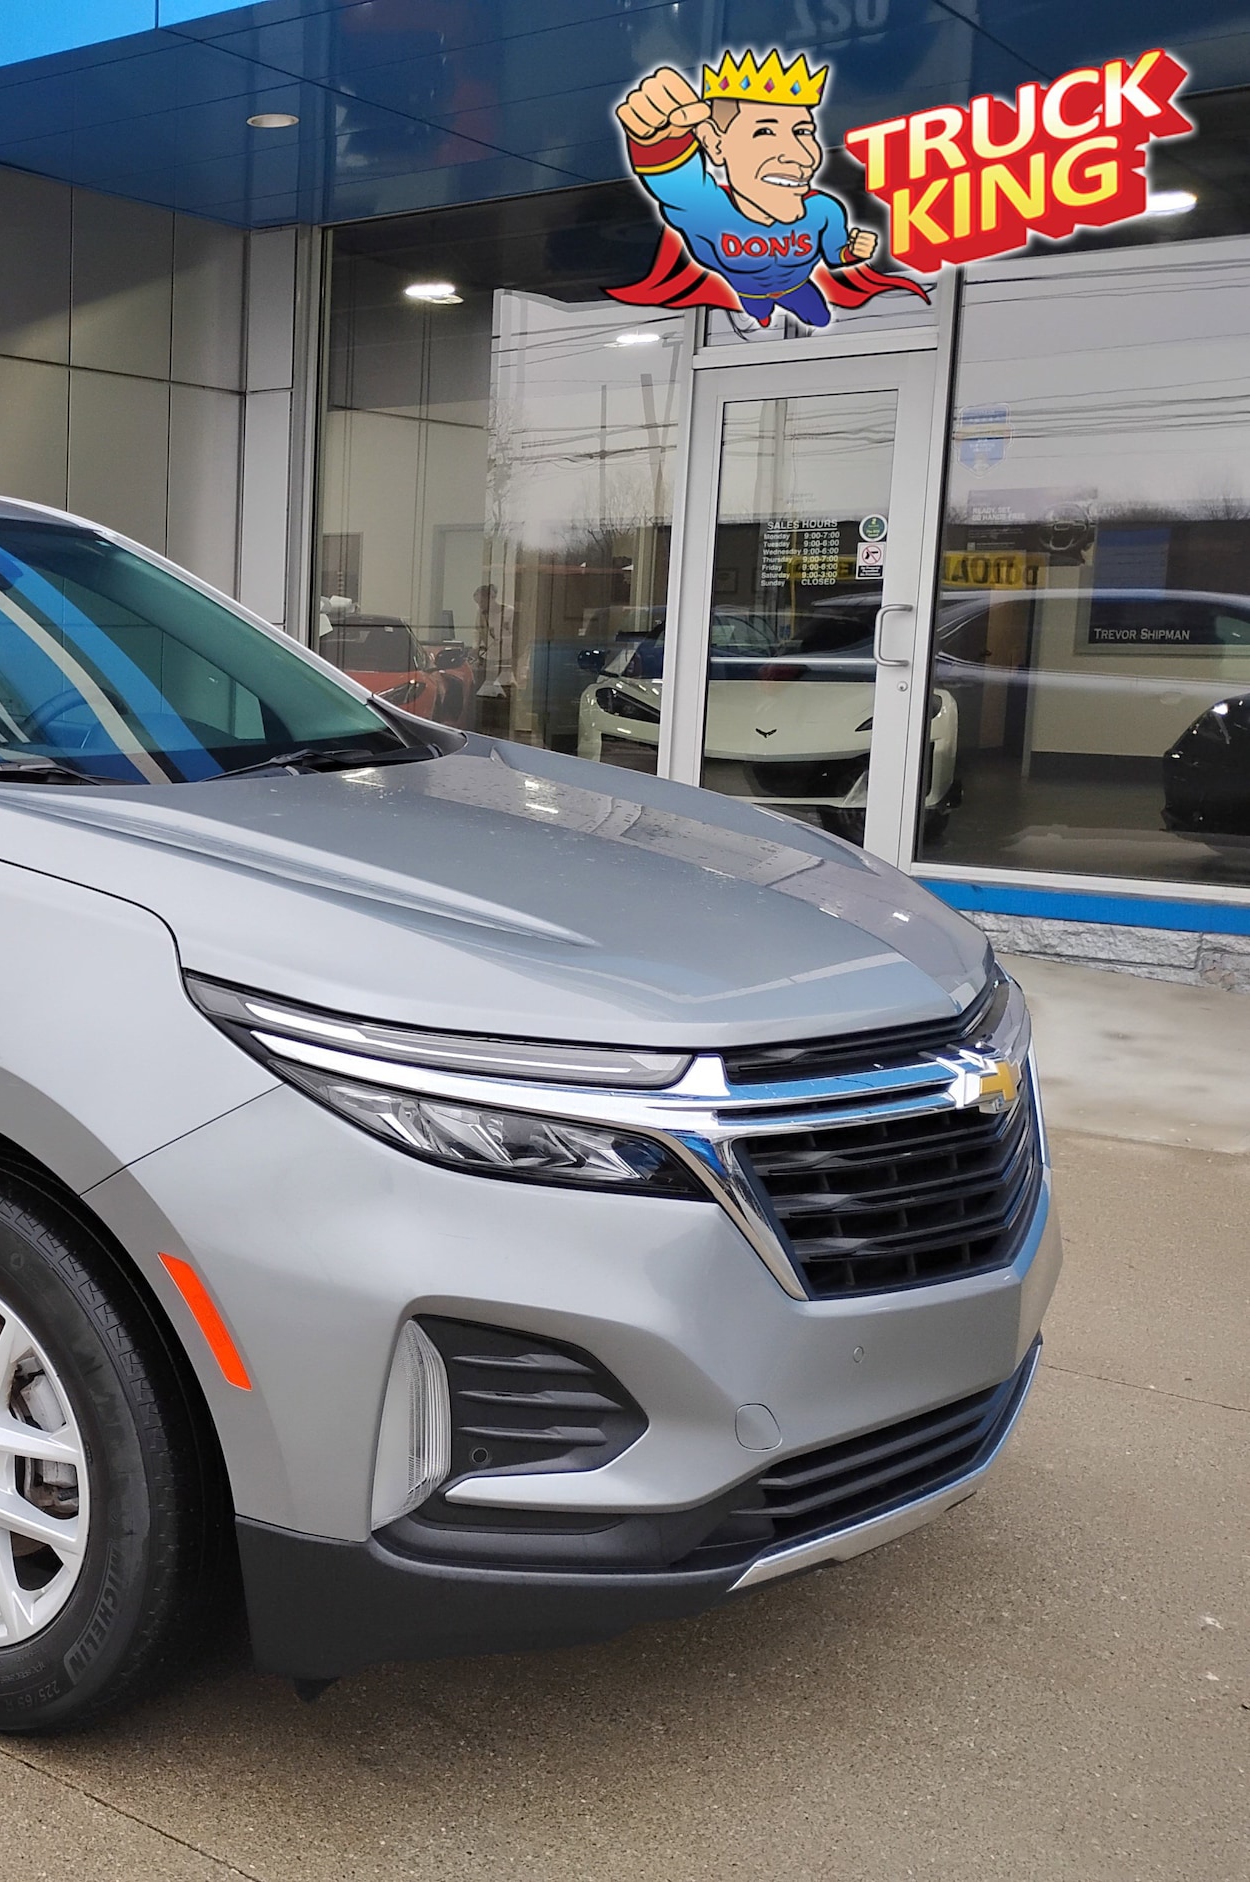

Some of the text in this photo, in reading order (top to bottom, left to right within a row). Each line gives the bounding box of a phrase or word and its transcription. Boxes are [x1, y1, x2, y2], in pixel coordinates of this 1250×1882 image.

[767, 519, 838, 531] SALES HOURS
[763, 533, 791, 541] Monday
[763, 541, 791, 549] Tuesday
[763, 548, 802, 556] Wednesday
[763, 556, 793, 564] Thursday
[761, 564, 783, 572] Friday
[760, 578, 836, 588] Sunday CLOSED
[1093, 627, 1191, 641] TREVOR SHIPMAN
